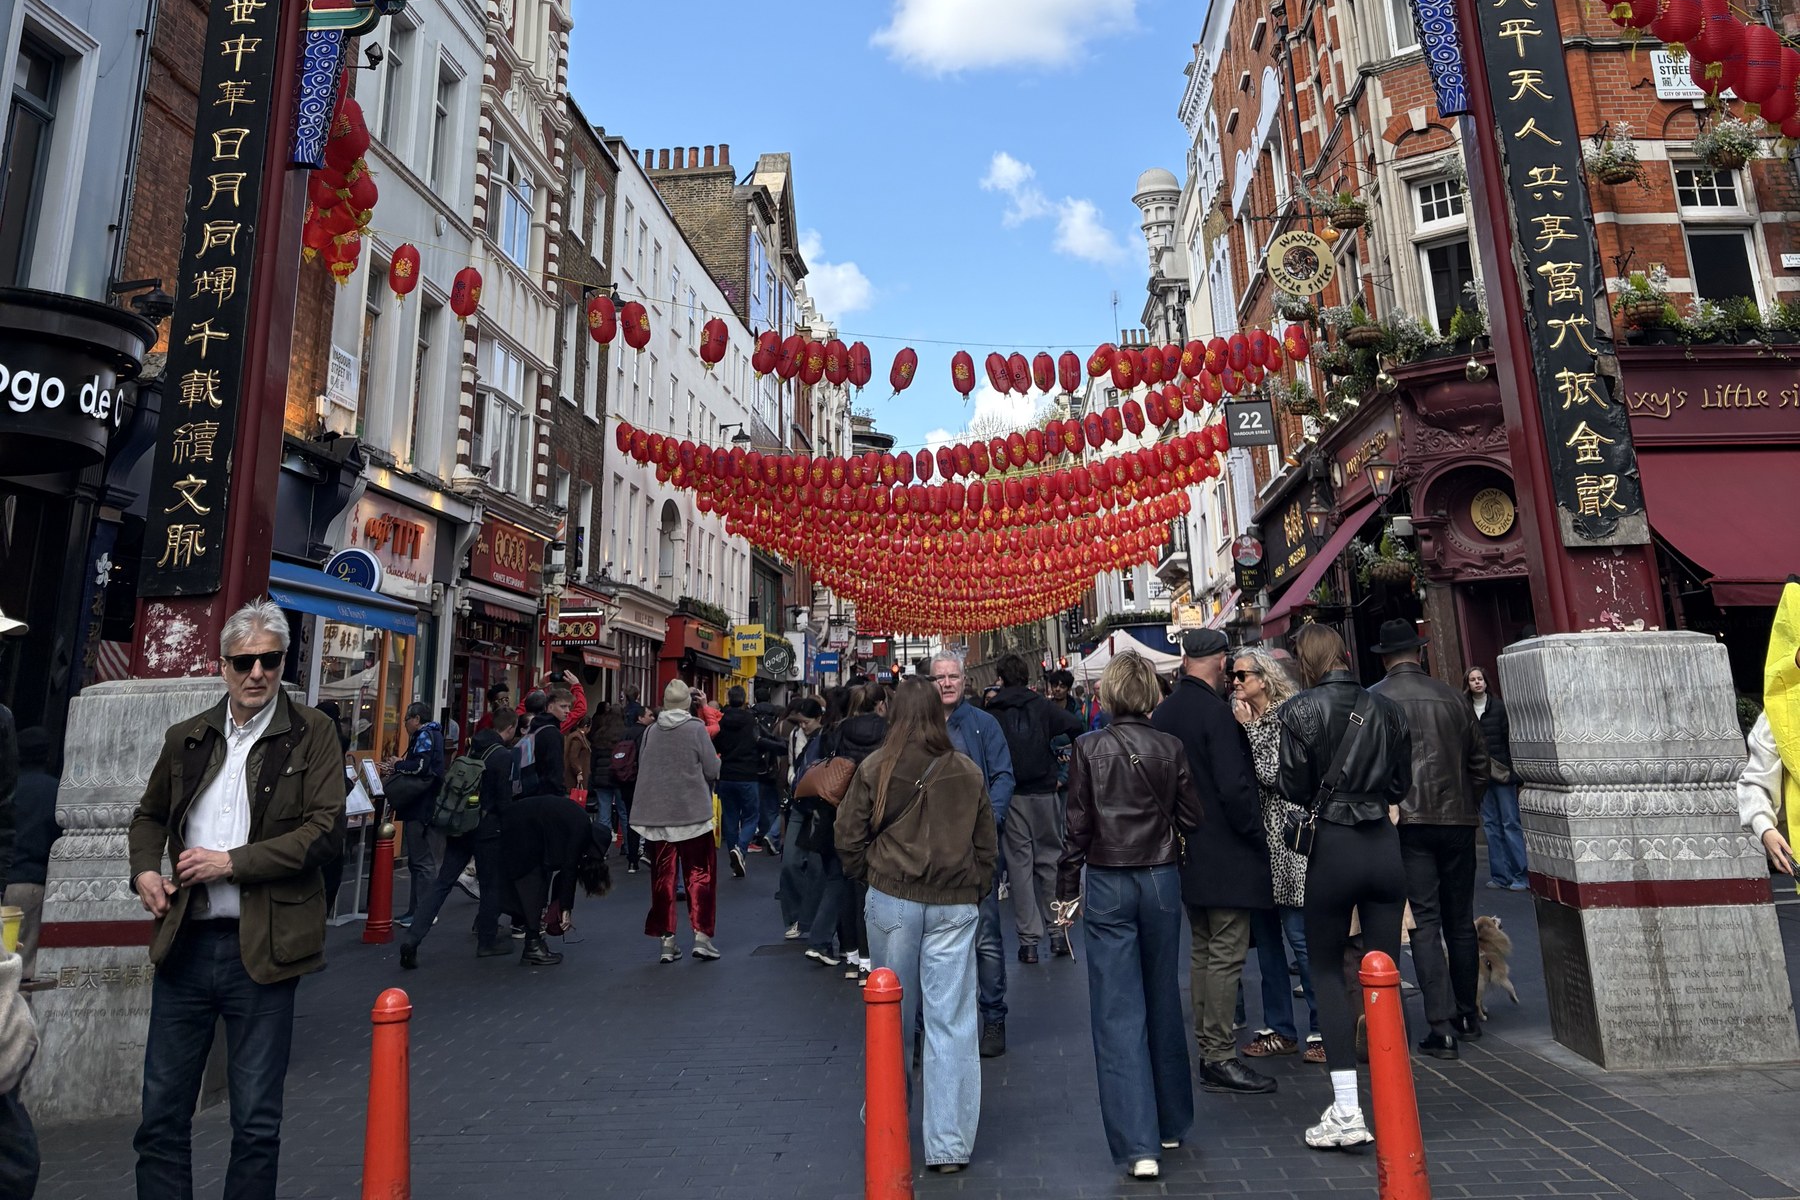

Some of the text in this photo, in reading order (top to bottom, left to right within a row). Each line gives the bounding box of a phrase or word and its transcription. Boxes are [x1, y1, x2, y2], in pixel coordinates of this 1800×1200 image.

[1660, 65, 1690, 75] STREE
[80, 375, 111, 419] de
[1626, 386, 1688, 419] xy's
[1238, 411, 1263, 429] 22
[392, 517, 425, 560] TPT
[559, 622, 596, 637] 興酒家
[1711, 1000, 1736, 1010] China
